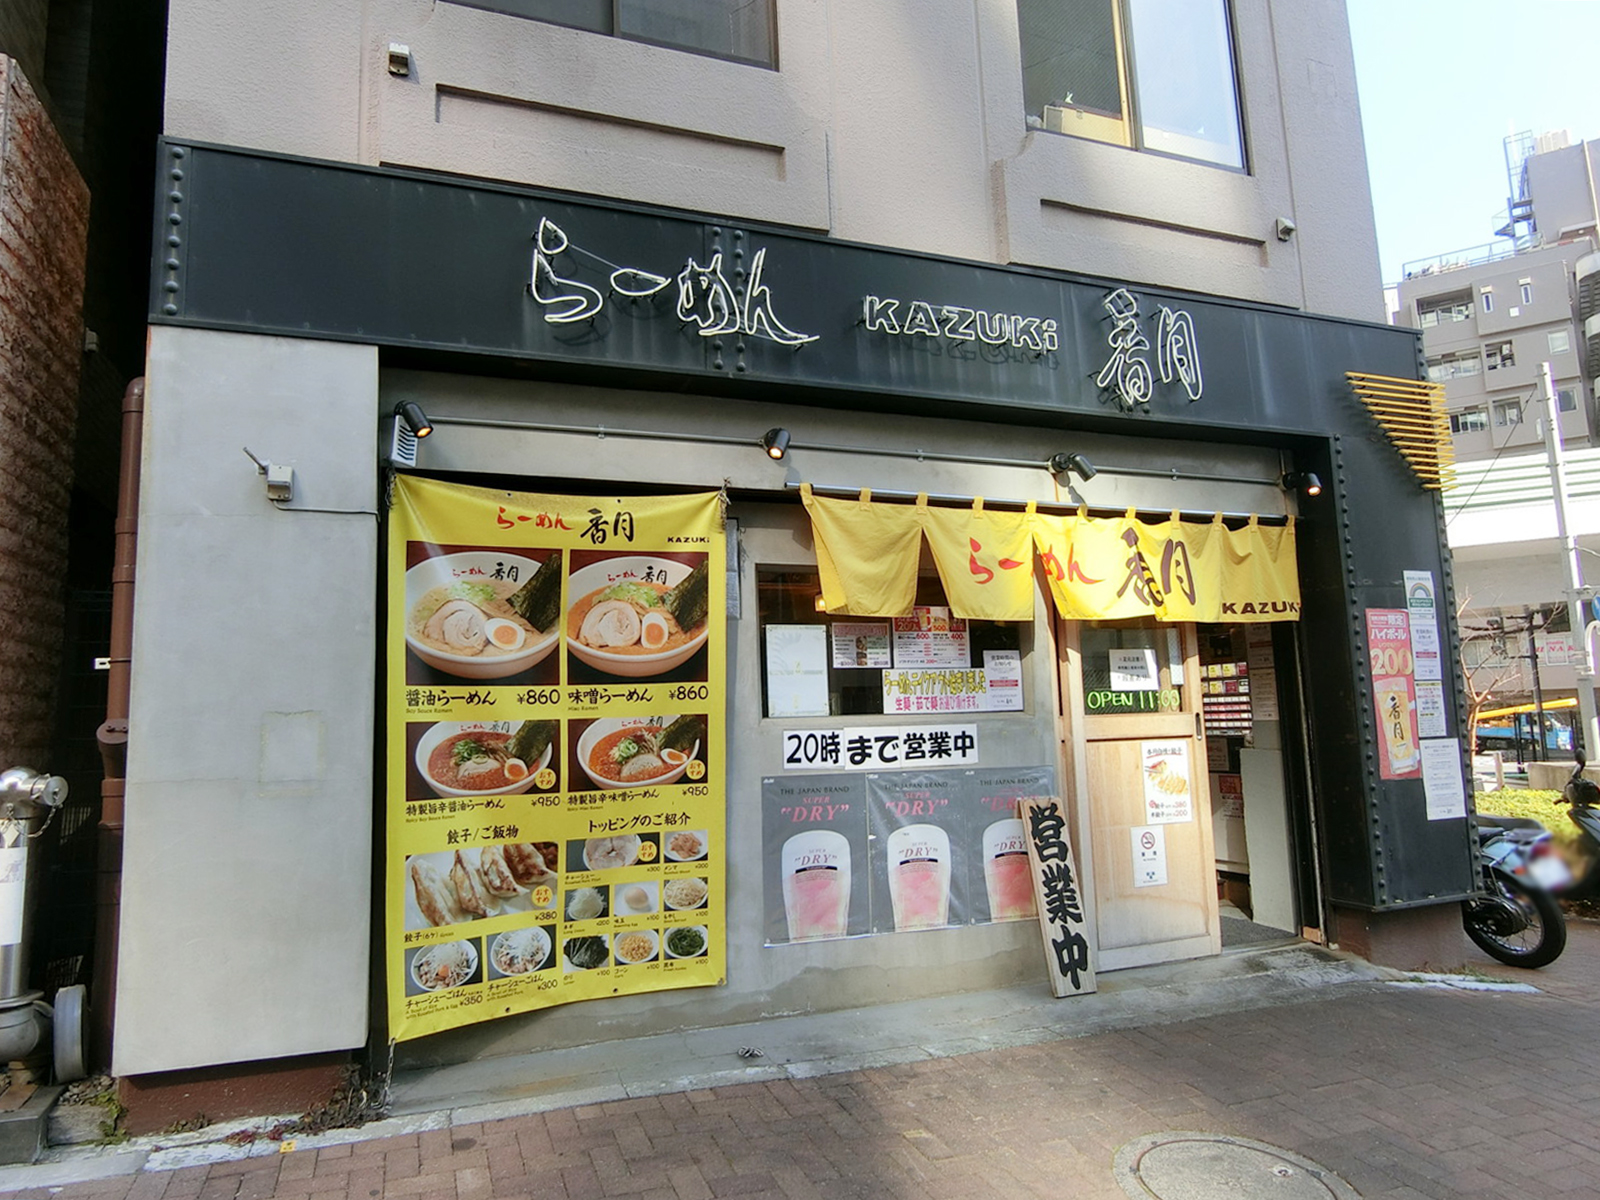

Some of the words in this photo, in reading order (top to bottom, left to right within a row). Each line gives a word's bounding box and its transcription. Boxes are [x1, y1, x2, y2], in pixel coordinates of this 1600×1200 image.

[529, 216, 821, 345] らーめん
[1096, 288, 1203, 404] 香月
[497, 506, 575, 530] らーめん
[580, 508, 635, 545] 香月
[968, 536, 1105, 585] らーめん
[1371, 627, 1407, 640] ハイボール
[405, 689, 497, 707] 醤油らーめん
[516, 688, 561, 705] ¥860
[567, 687, 654, 704] 味噌らーめん
[668, 685, 709, 701] ¥860
[1087, 691, 1133, 709] OPEN
[786, 731, 976, 766] 20時まで営業中
[798, 786, 822, 795] JAPAN
[824, 786, 850, 794] BRAND
[924, 781, 948, 789] BRAND
[531, 796, 561, 807] ¥950
[588, 811, 691, 833] トッピングのご紹介
[446, 824, 519, 845] 餃子/ご飯物
[1029, 801, 1089, 990] 営業中
[487, 974, 543, 992] チャーシューごはん
[405, 988, 466, 1009] チャーシューごはん
